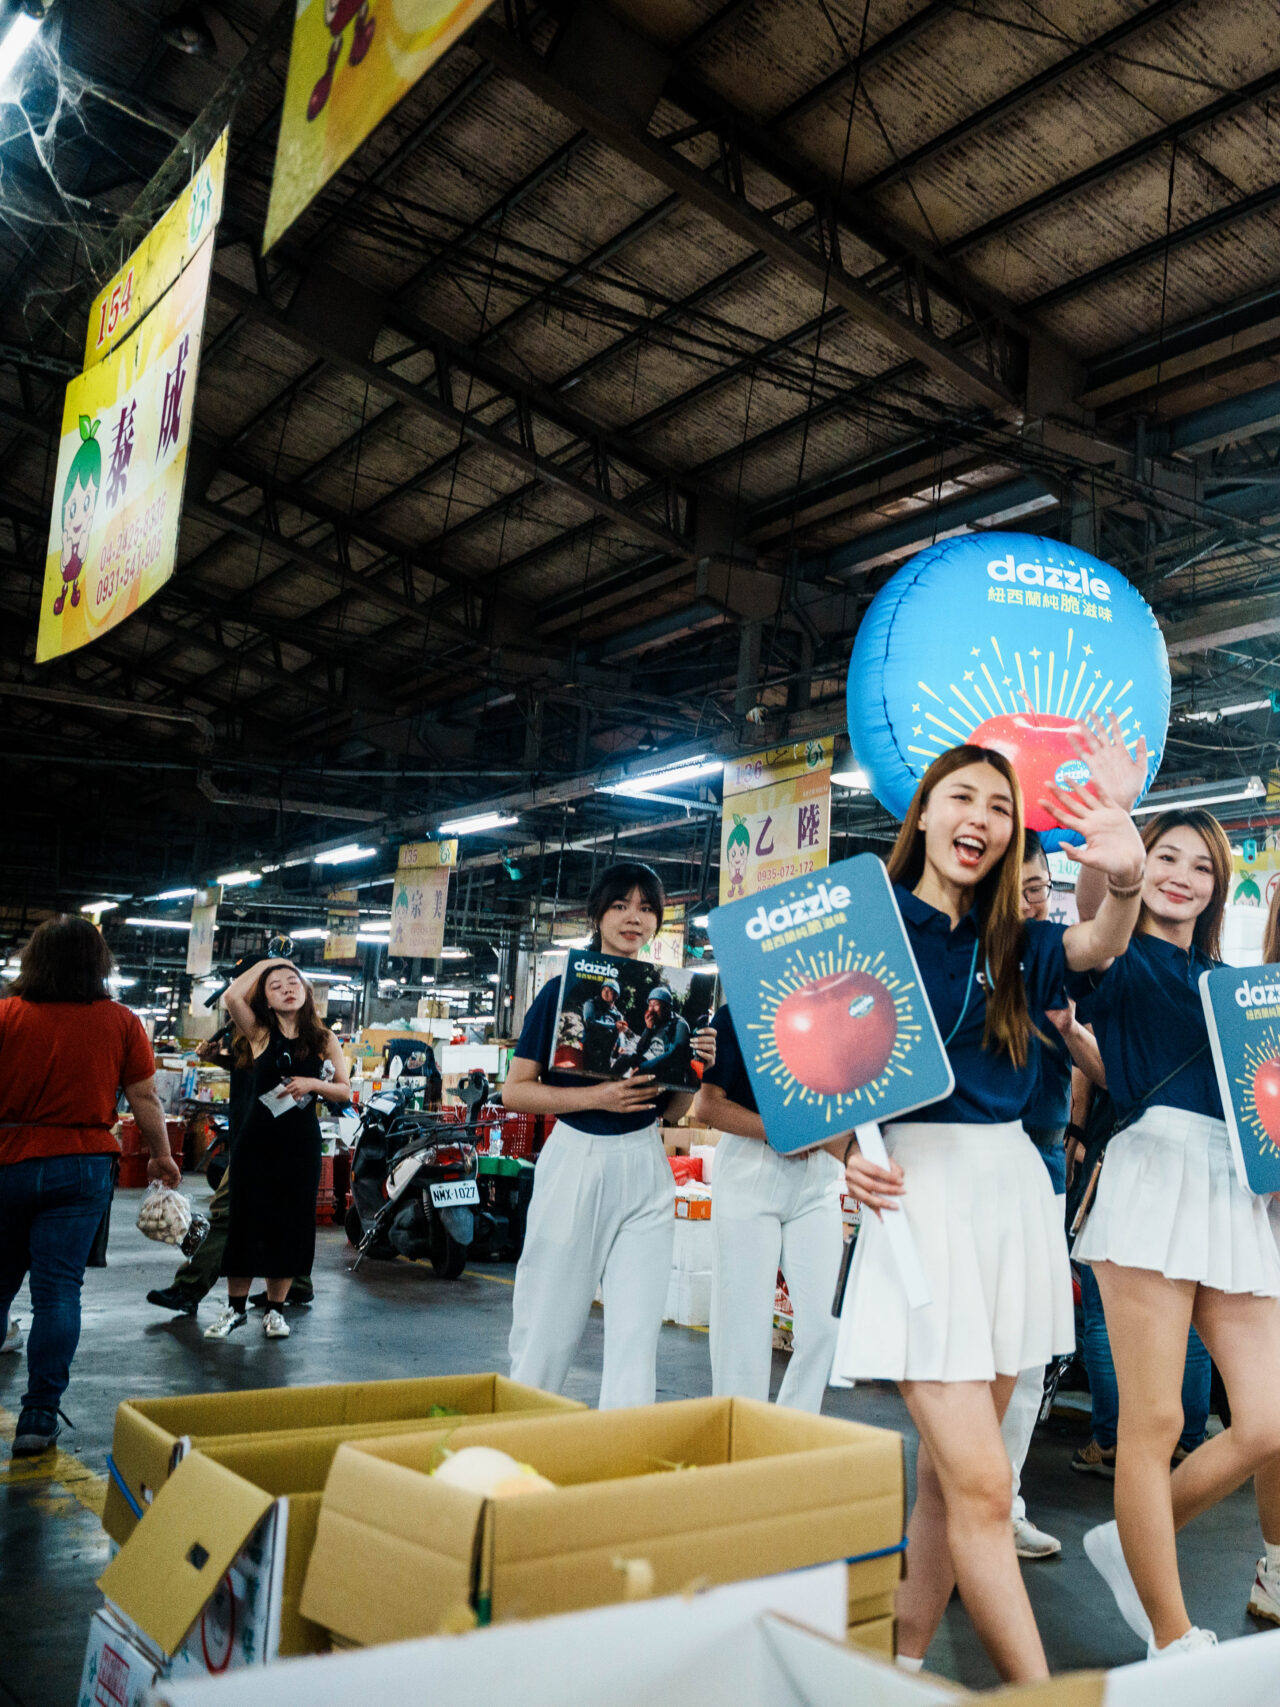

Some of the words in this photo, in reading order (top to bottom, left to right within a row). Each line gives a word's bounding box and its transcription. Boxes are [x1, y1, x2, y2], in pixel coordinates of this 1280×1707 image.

[97, 270, 134, 346] 154
[105, 333, 190, 509] 泰成
[987, 554, 1112, 602] dazzle
[988, 586, 1113, 622] 紐西蘭純脆滋味
[736, 760, 763, 785] 136
[756, 804, 820, 856] 乙陸
[757, 861, 814, 882] 0935-072-172
[745, 884, 851, 940] dazzle
[574, 959, 619, 978] dazzle
[433, 1187, 476, 1202] NMX-1027
